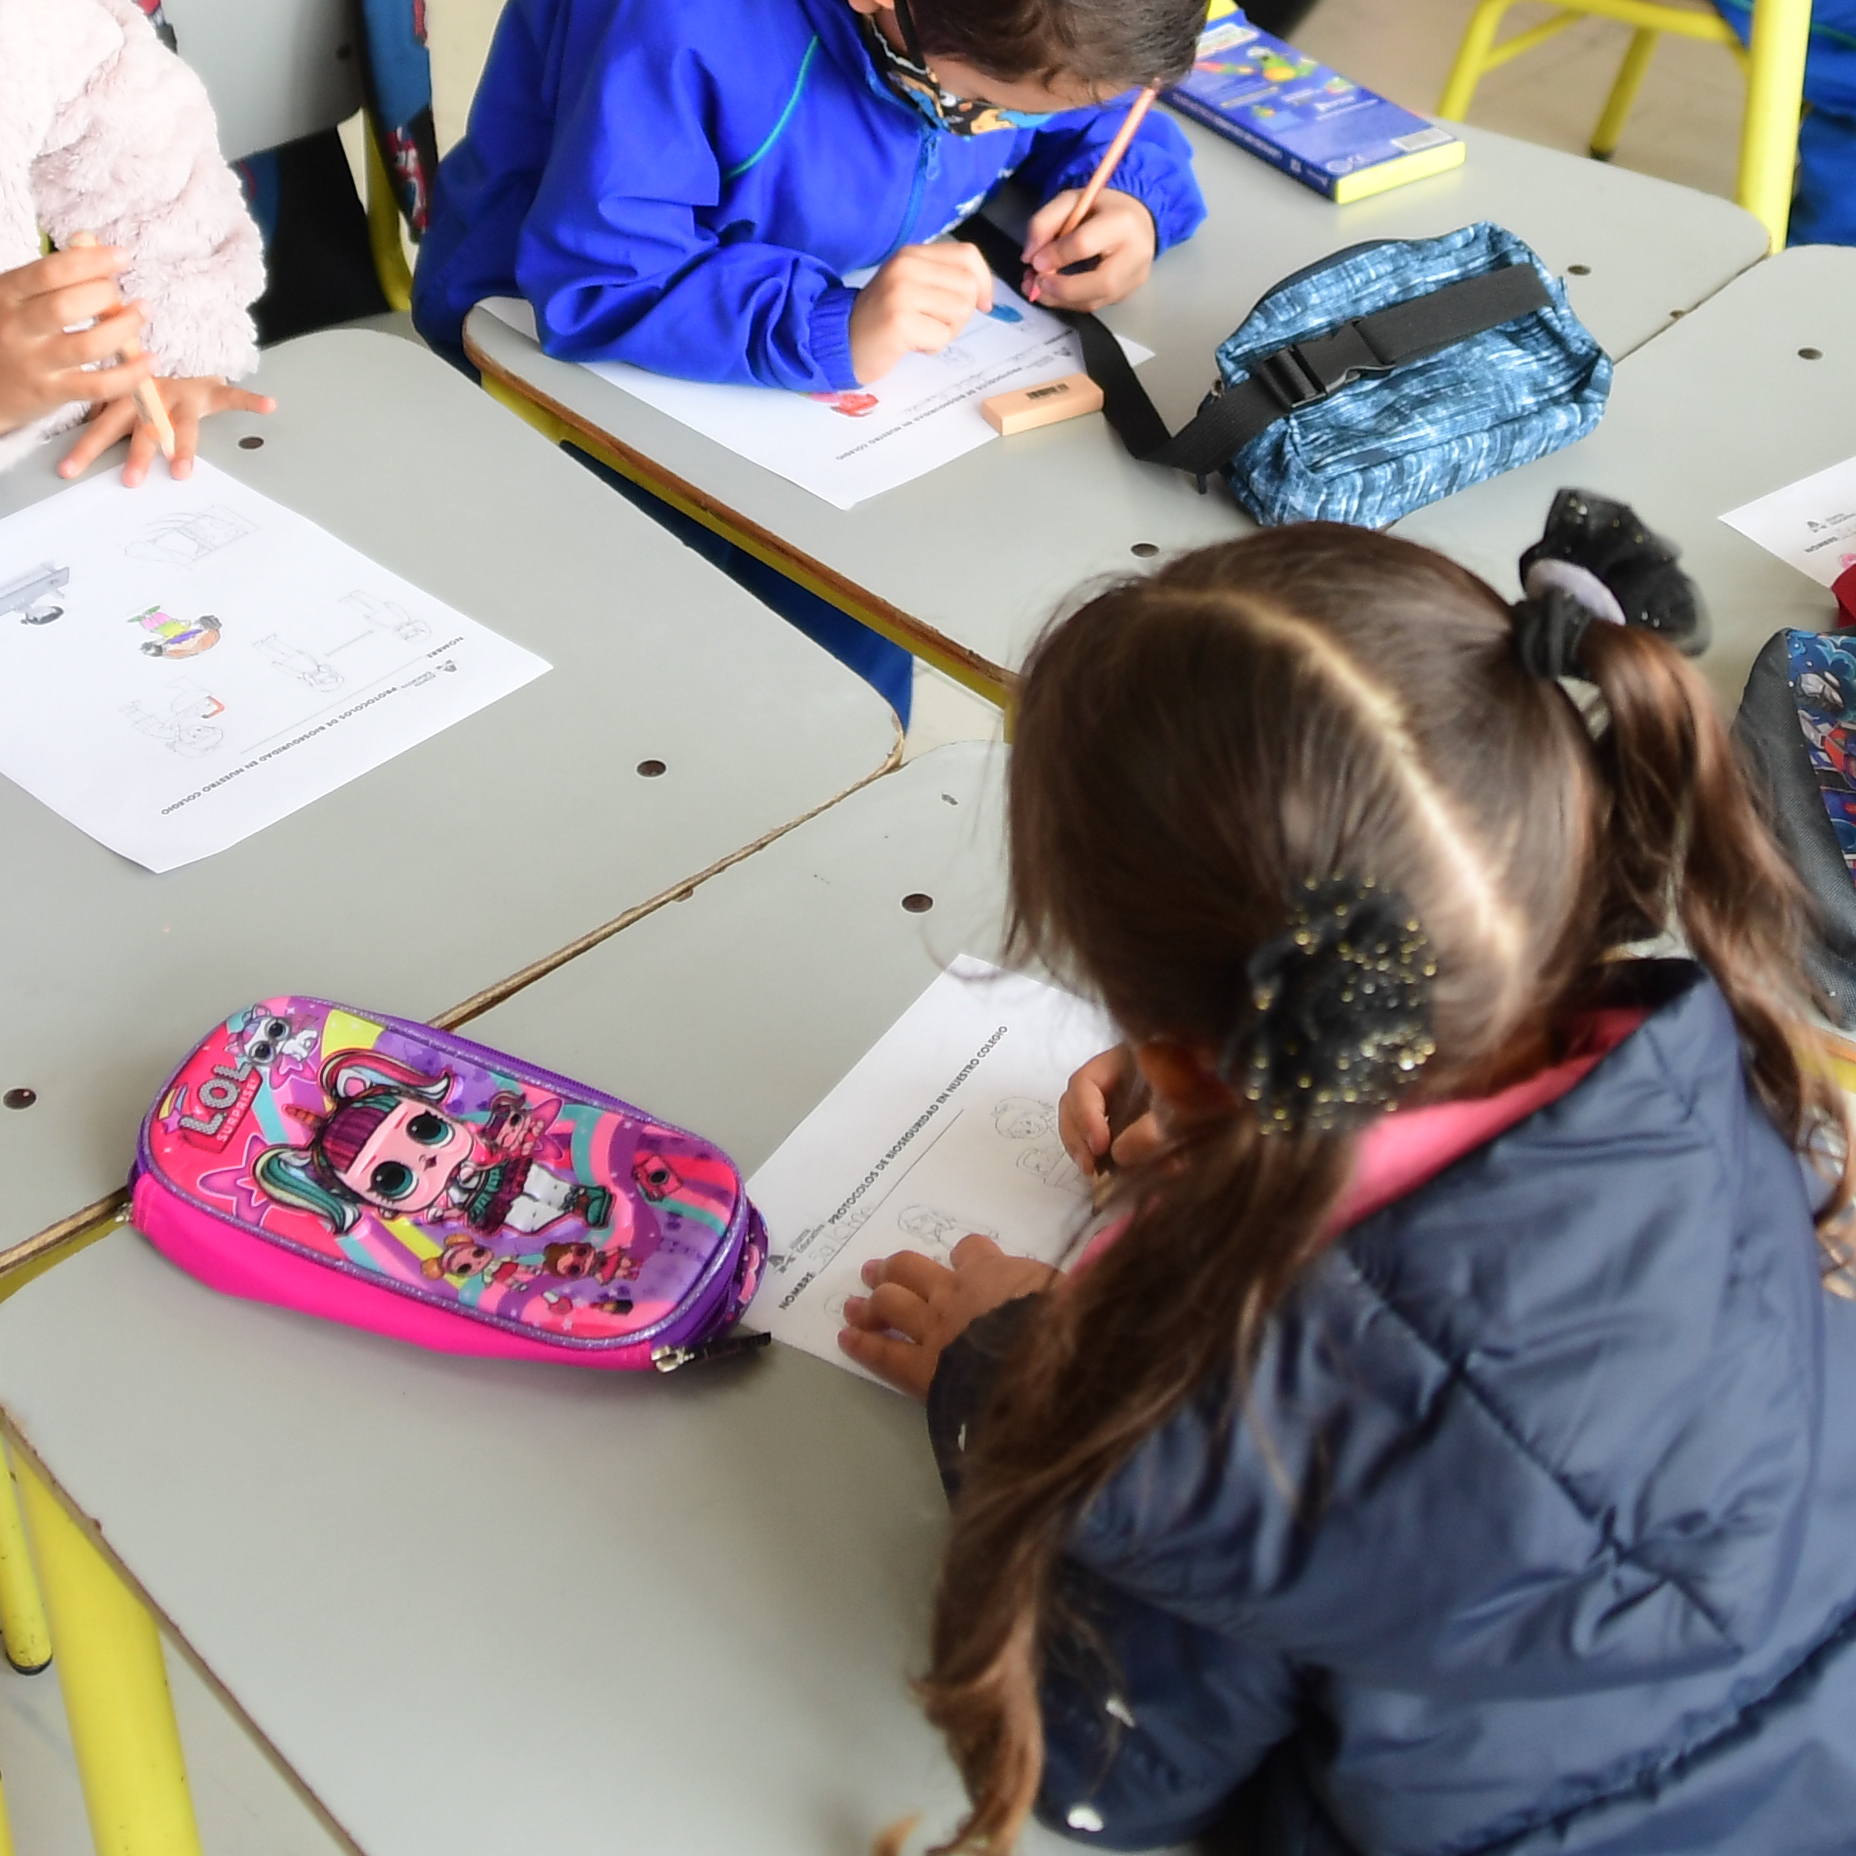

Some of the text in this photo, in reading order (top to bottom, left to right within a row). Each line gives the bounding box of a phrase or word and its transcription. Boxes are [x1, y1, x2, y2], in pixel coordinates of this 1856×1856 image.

[161, 686, 398, 816] PROTOCOLOS DE BIOSEGURIDAD EN NUESTRO COLEGIO
[216, 1078, 256, 1142] SURPRISE!
[828, 1025, 1008, 1225] PROTOCOLOS DE BIOSEGURIDAD EN NUESTRO COLEGIO
[778, 1271, 816, 1311] NOMBRE
